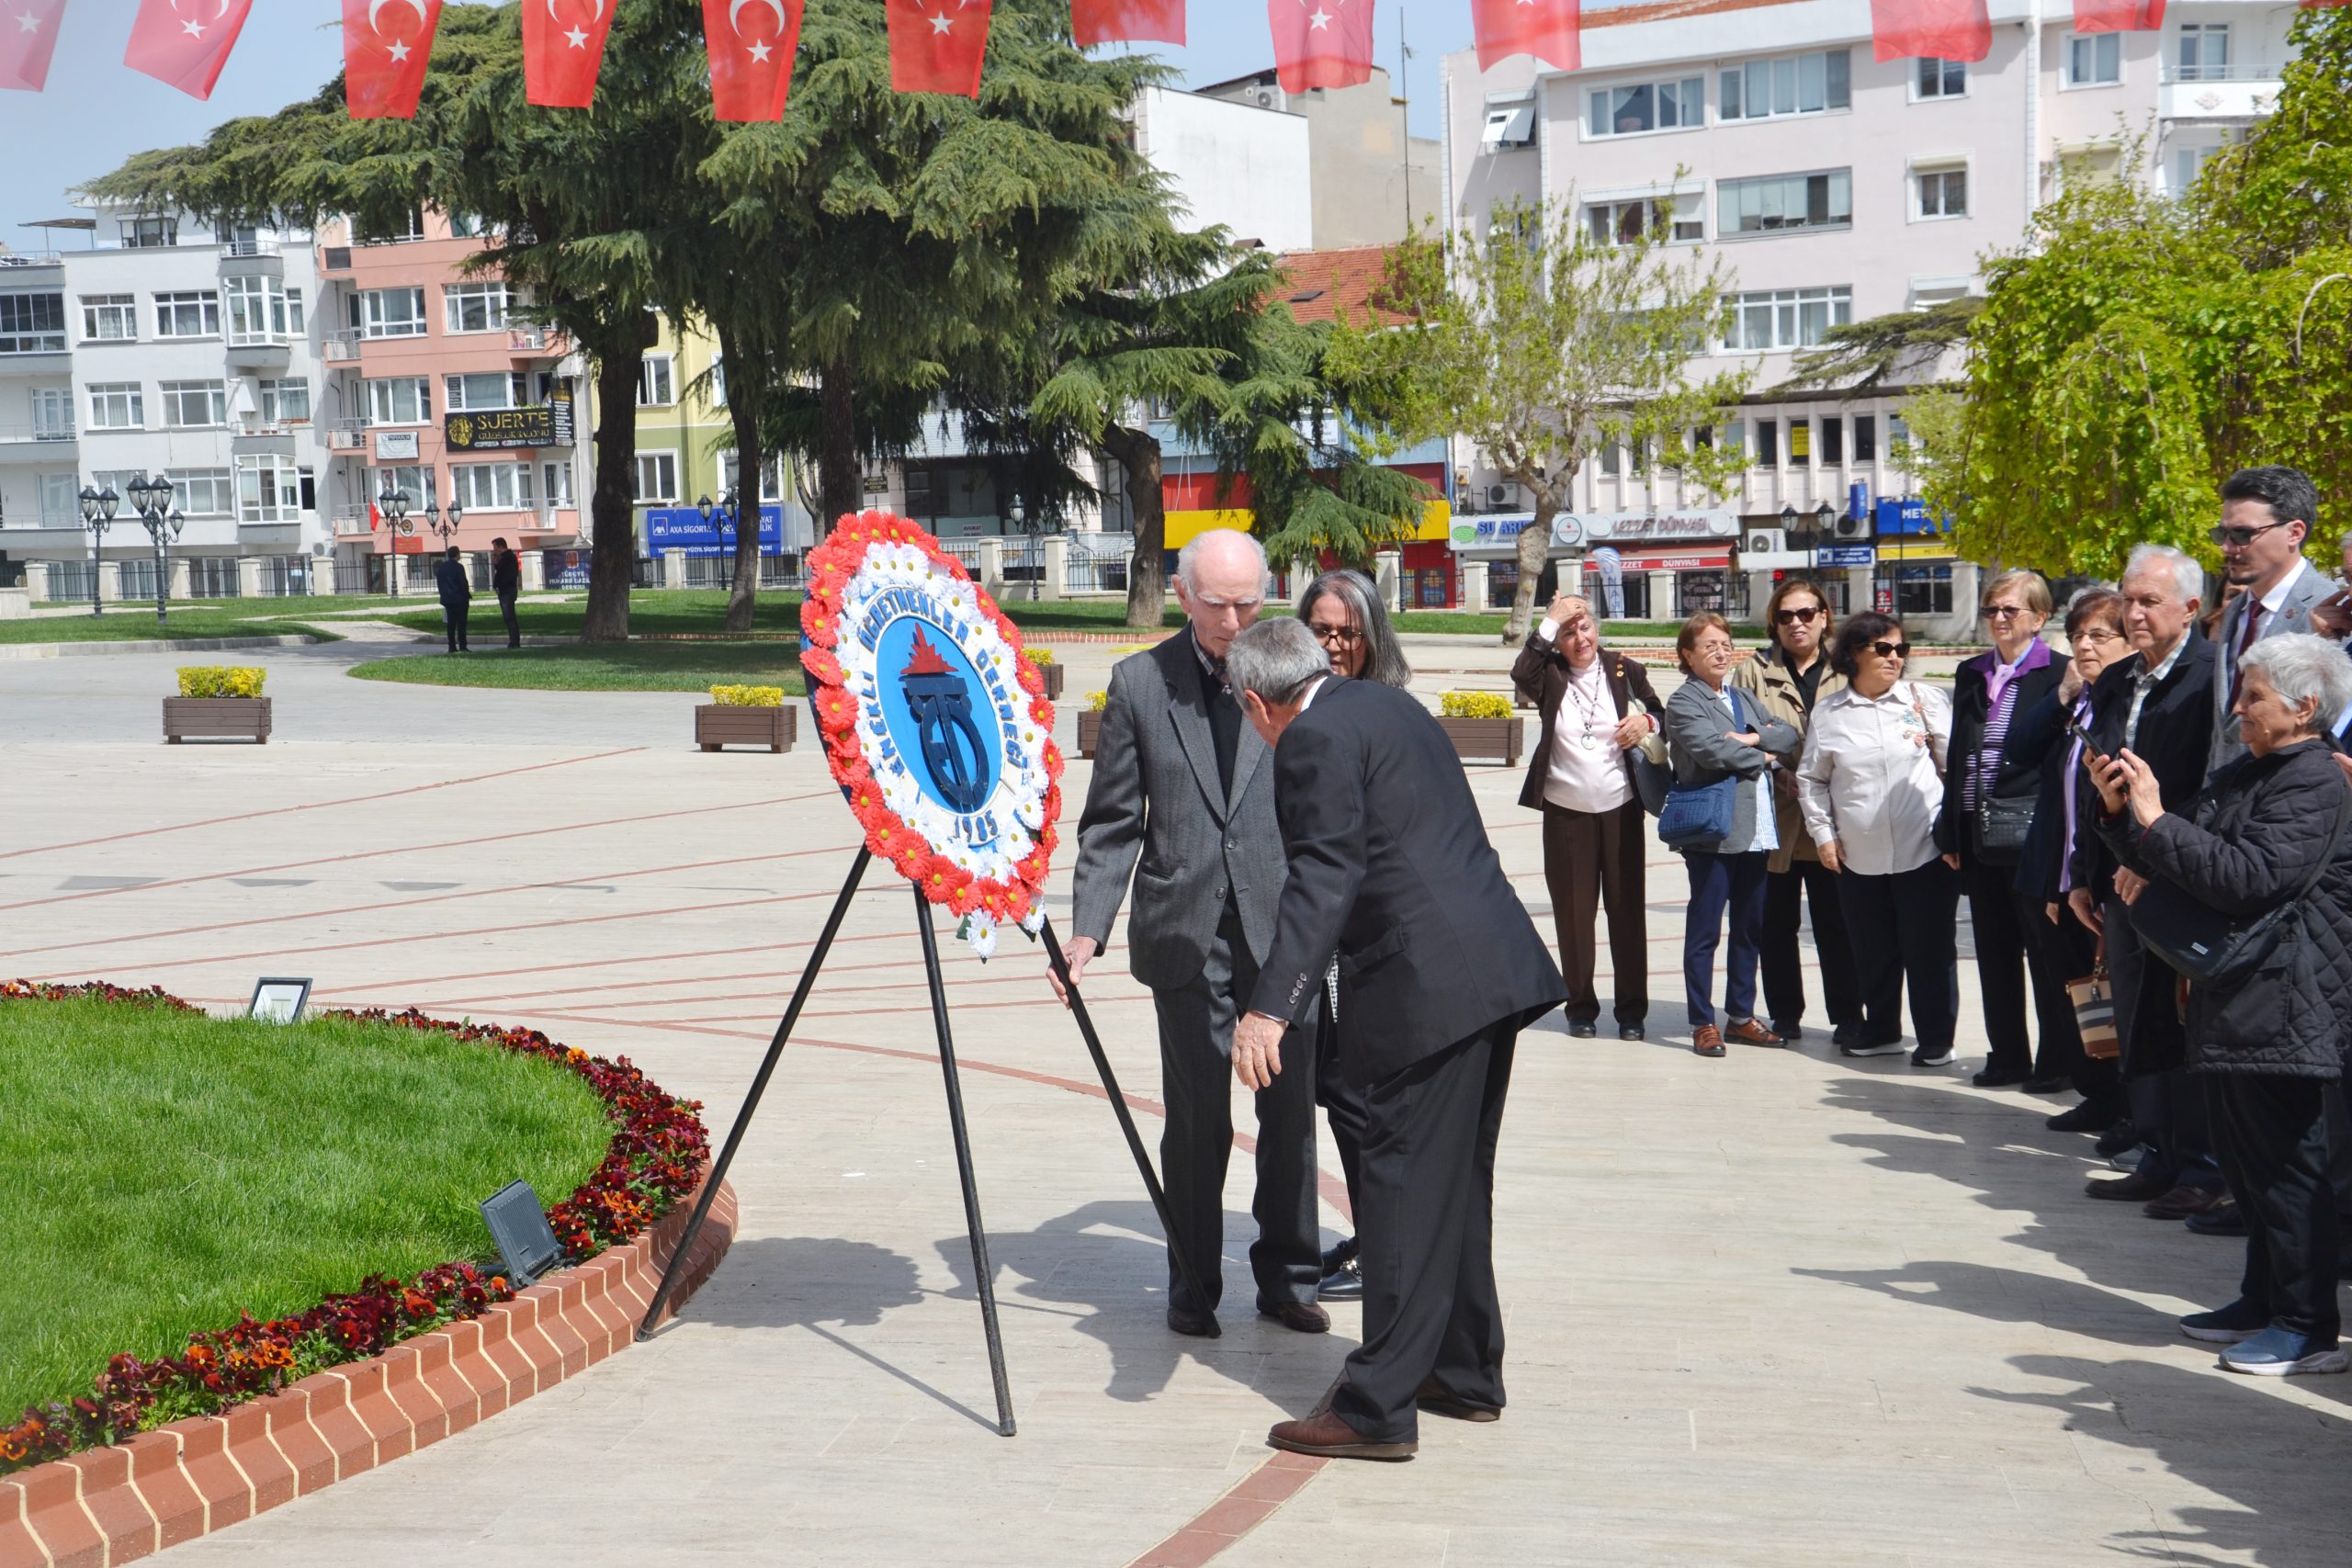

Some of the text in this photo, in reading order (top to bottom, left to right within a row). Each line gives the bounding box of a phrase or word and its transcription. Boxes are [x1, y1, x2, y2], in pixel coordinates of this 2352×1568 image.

[670, 525, 683, 534] AXA
[1477, 521, 1496, 535] SU
[1613, 517, 1657, 534] LEZZET
[955, 809, 999, 842] 1985
